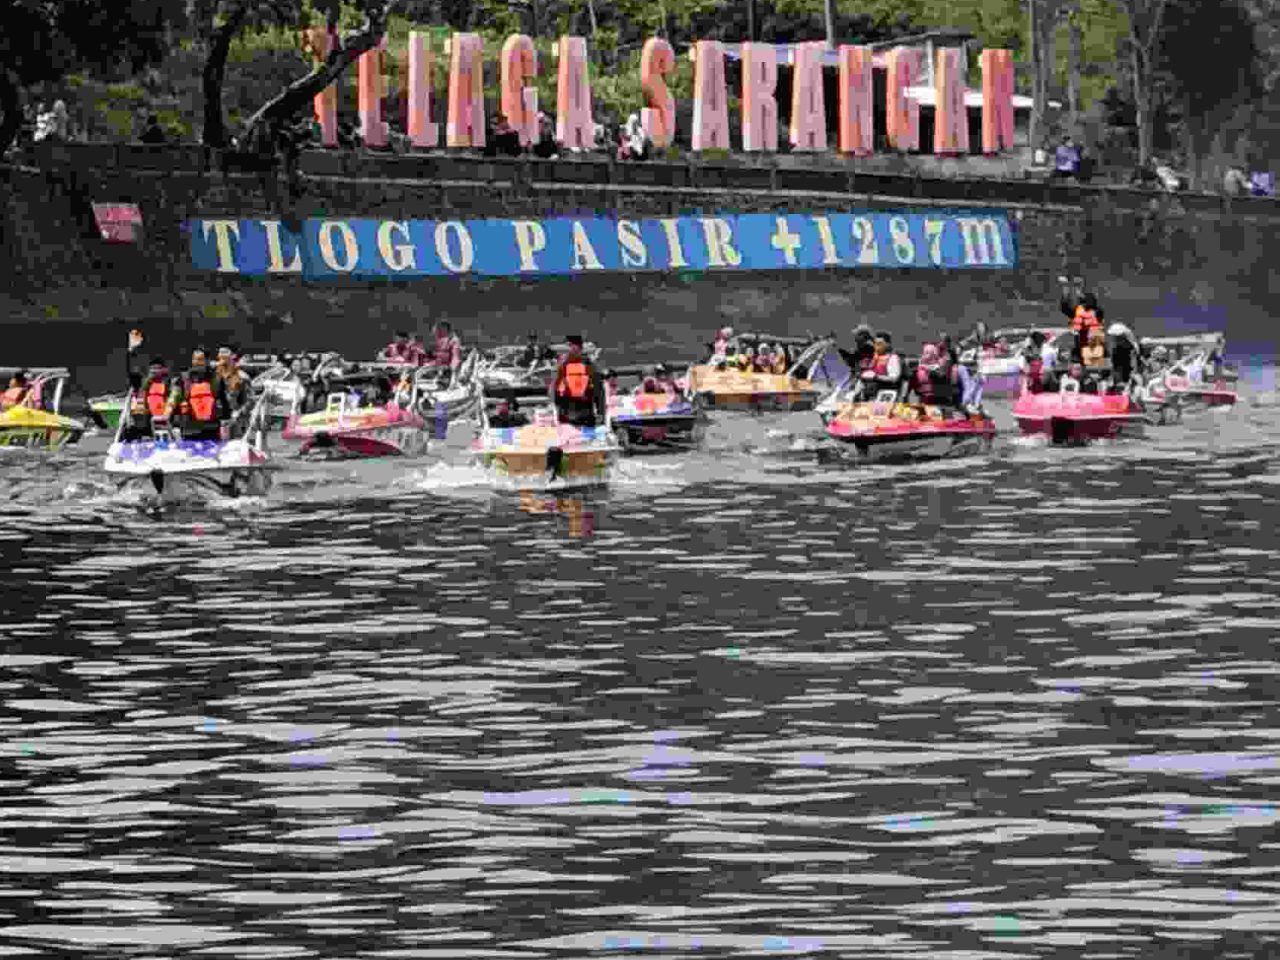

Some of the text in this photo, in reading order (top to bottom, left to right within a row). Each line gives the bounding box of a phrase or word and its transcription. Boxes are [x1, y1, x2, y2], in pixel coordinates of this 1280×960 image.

[641, 37, 1015, 156] SARANGAN
[202, 218, 474, 272] TLOGO
[511, 218, 742, 271] PASIR
